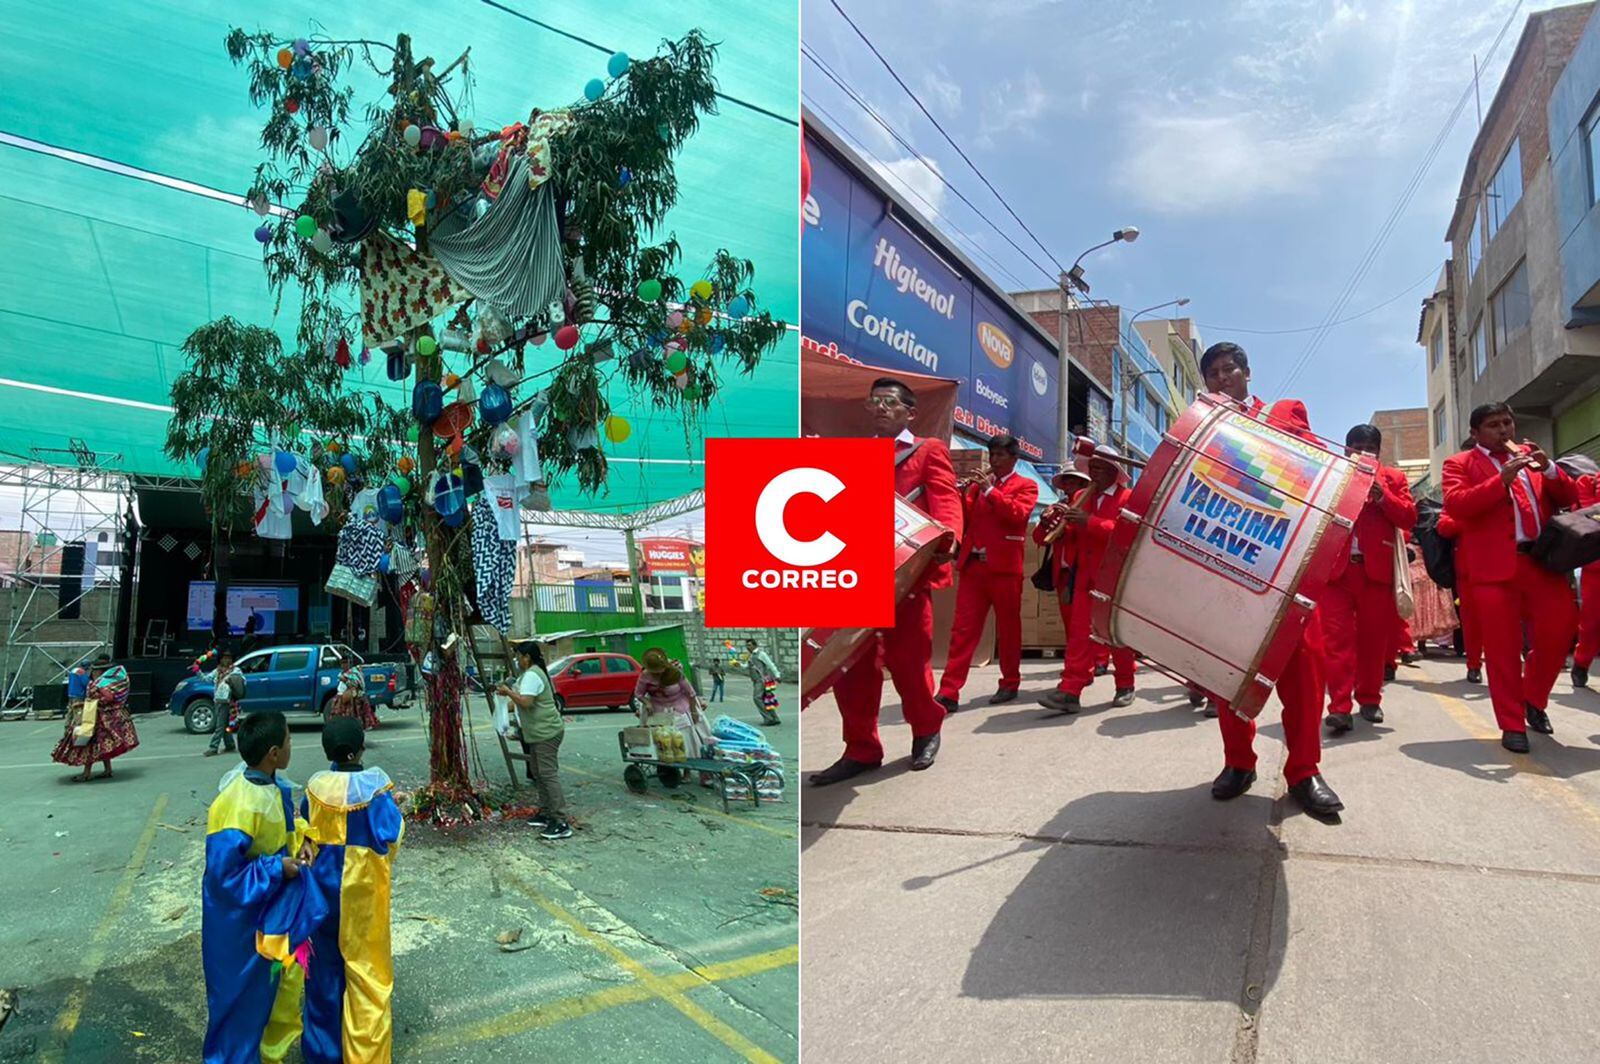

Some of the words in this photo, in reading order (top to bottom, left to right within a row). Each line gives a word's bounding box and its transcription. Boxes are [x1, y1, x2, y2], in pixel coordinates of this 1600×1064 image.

[873, 238, 955, 321] Higienol
[846, 299, 939, 373] Cotidian
[981, 325, 1011, 362] Nova
[975, 378, 1009, 410] Babysec
[1180, 472, 1291, 551] YAURIMA
[648, 550, 686, 560] HUGGIES
[1183, 513, 1262, 565] ILAVE
